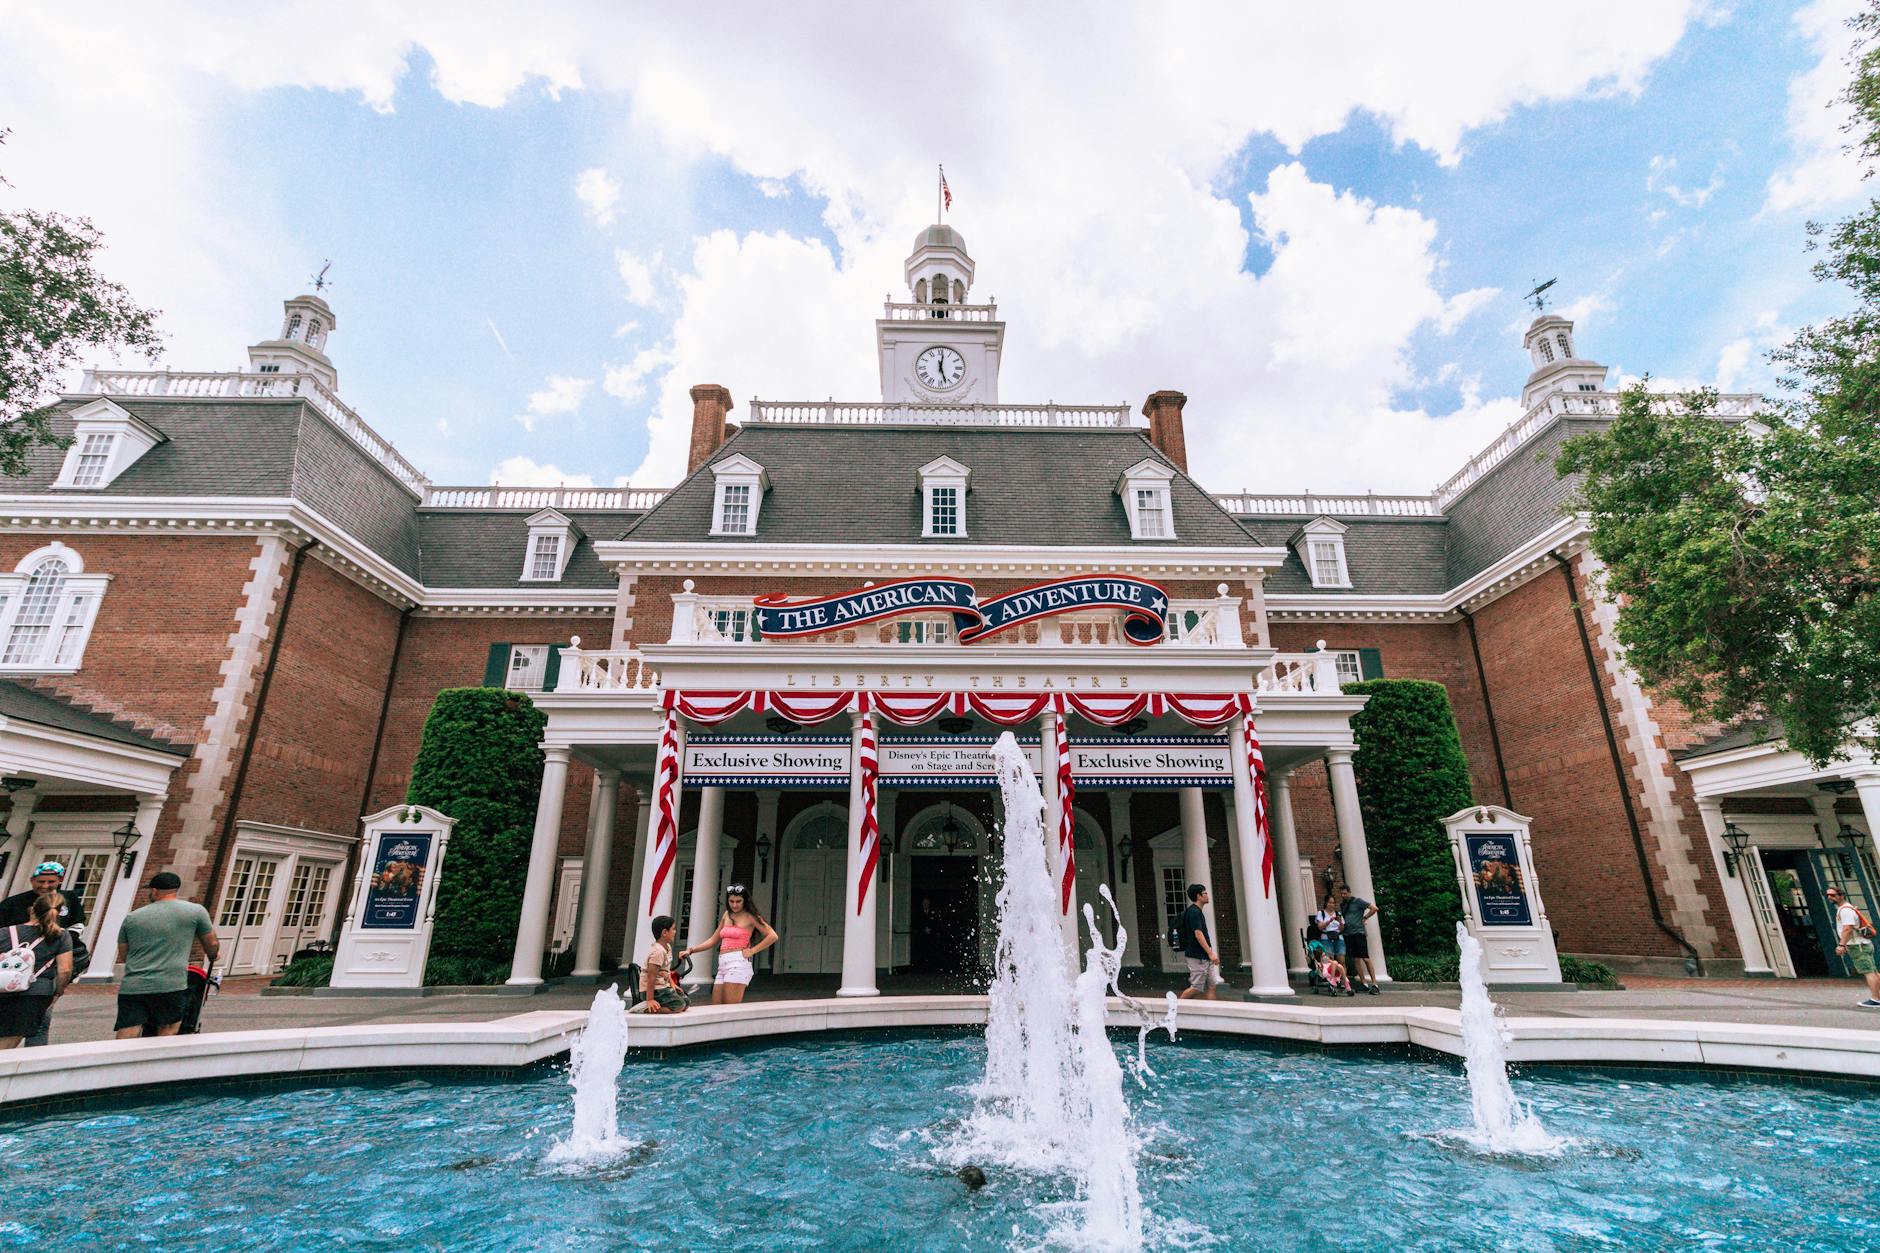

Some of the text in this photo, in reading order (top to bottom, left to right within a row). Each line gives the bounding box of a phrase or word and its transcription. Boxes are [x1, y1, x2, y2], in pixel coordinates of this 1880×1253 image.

[778, 583, 1142, 630] THE AMERICAN ADVENTURE
[787, 674, 1128, 688] LIBERTY THEATRE
[693, 753, 842, 770] Exclusive Showing
[888, 751, 995, 761] Disney's Epic Theatric
[1078, 754, 1224, 771] Exclusive Showing
[927, 762, 953, 771] Stage
[955, 761, 973, 770] and
[976, 762, 995, 770] Scre
